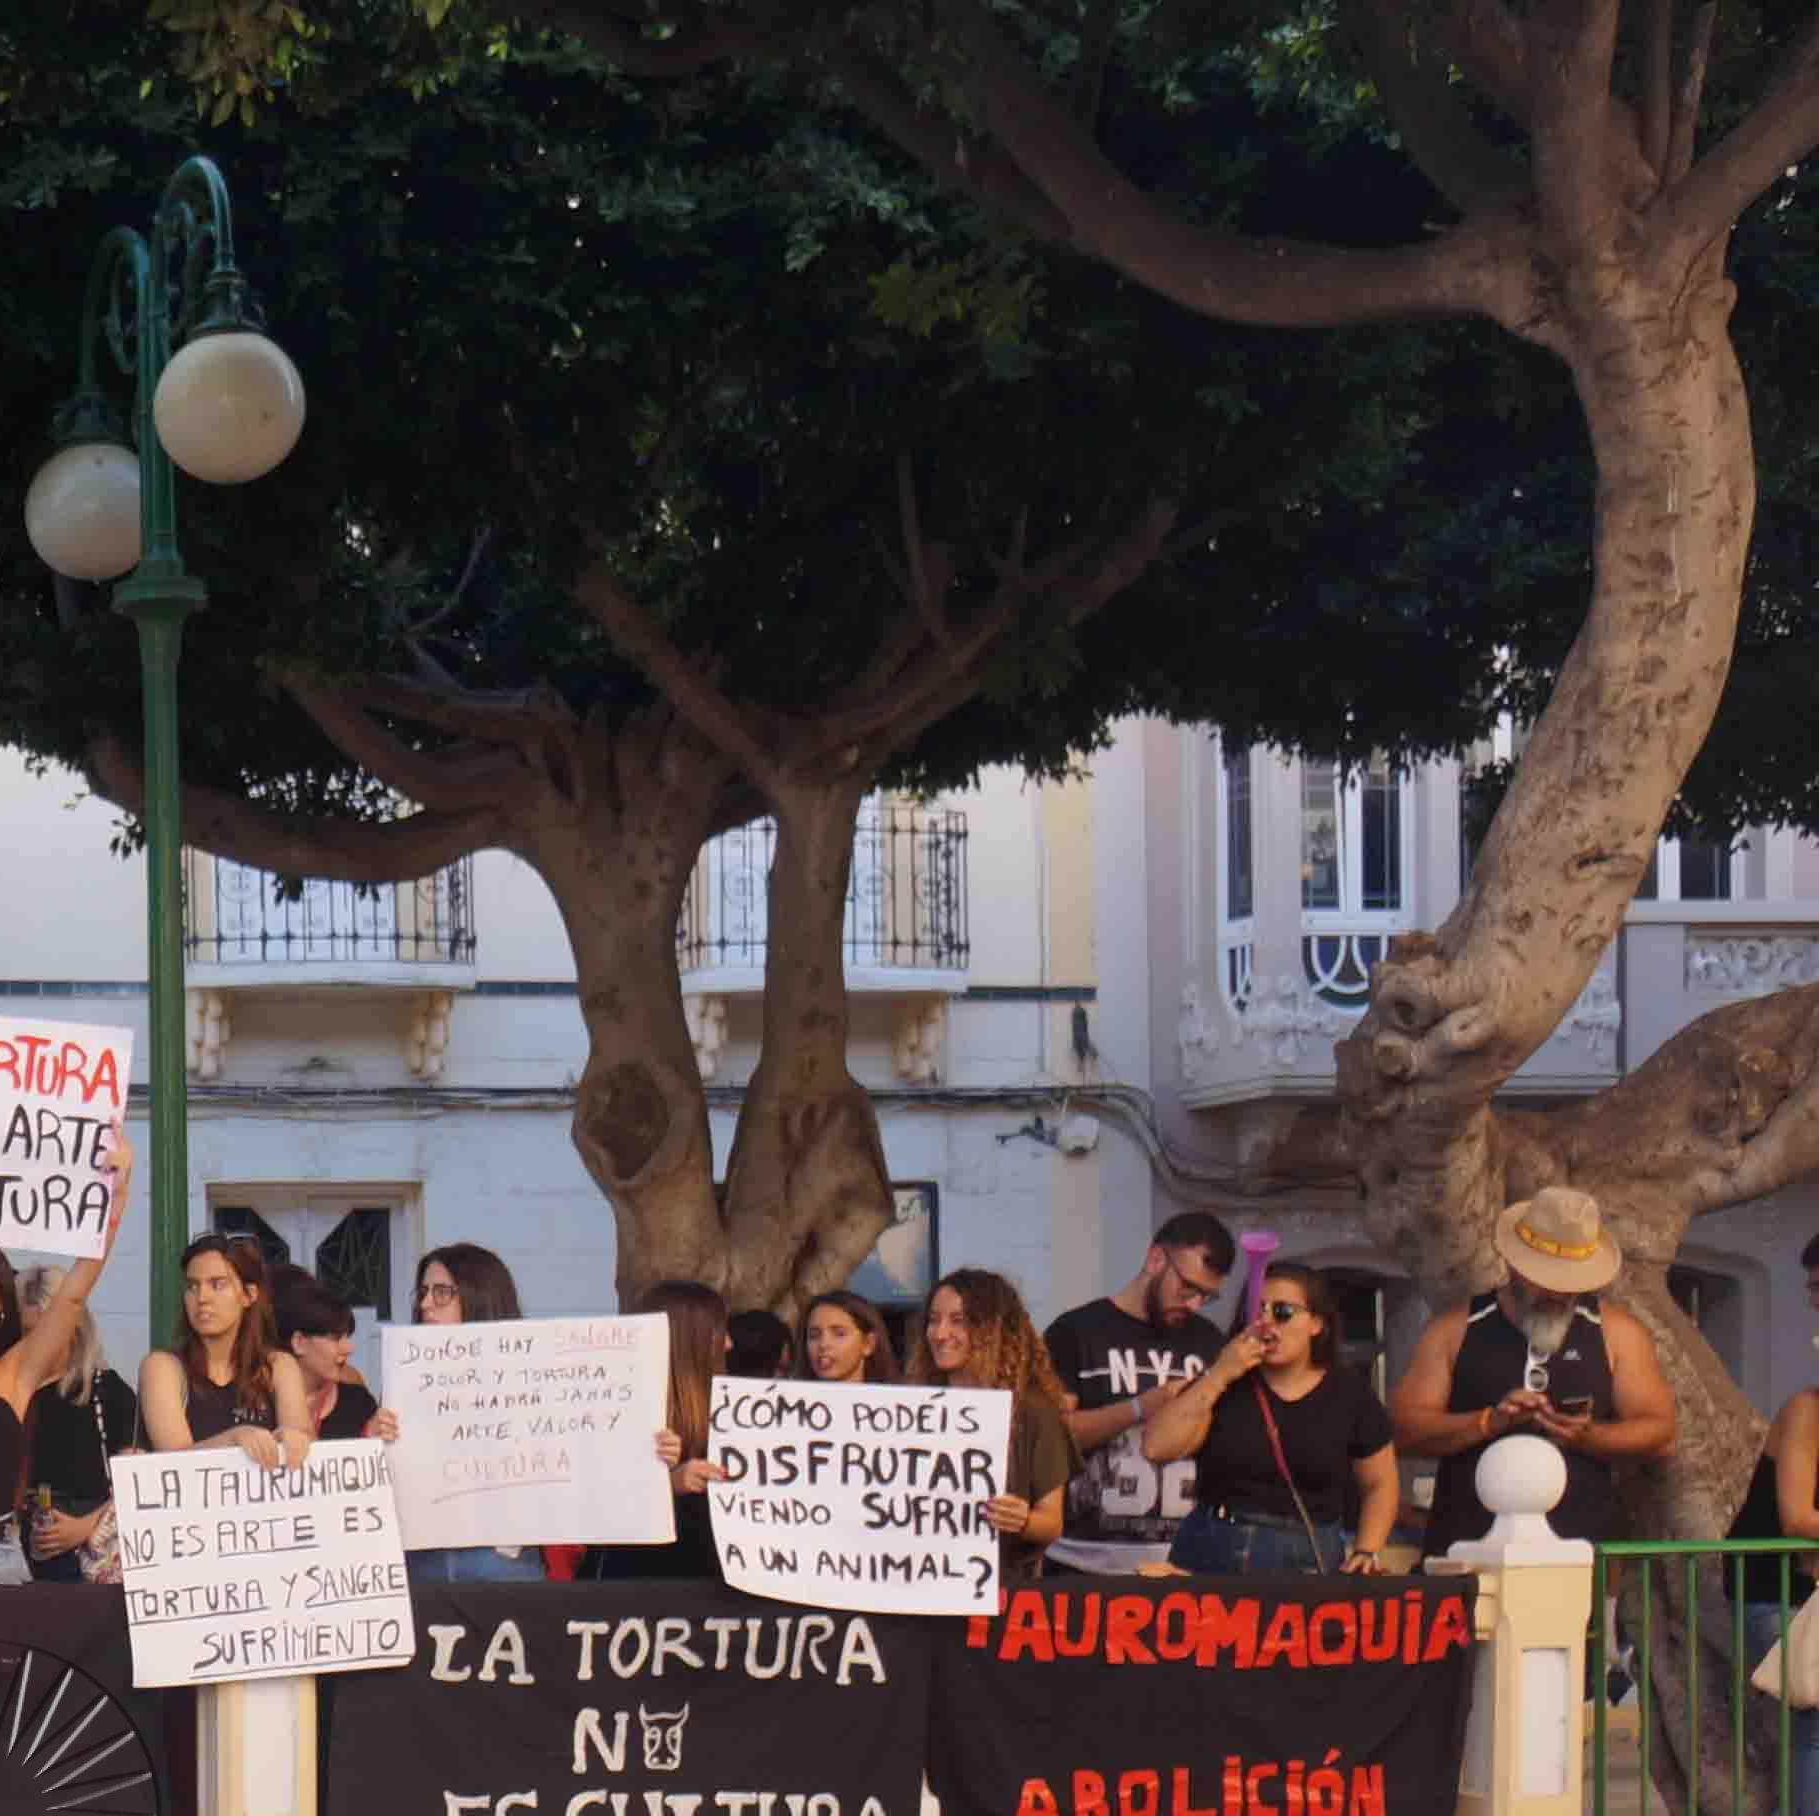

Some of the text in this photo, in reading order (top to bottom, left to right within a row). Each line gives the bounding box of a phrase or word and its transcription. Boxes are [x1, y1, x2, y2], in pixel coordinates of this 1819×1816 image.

[2, 1103, 117, 1173] ARTE
[712, 1383, 980, 1433] ¿CÓMO PODÉIS
[132, 1469, 182, 1511] LA
[720, 1441, 997, 1496] DISFRUTAR
[123, 1506, 383, 1564] NO ES ARTE ES
[861, 1491, 997, 1542] SUFRIR
[725, 1543, 747, 1569] A
[759, 1545, 799, 1574] UN
[124, 1562, 406, 1624] TORTURA Y SANGRE
[193, 1618, 401, 1671] SUFRIMIENTO
[426, 1613, 889, 1686] LA TORTURA
